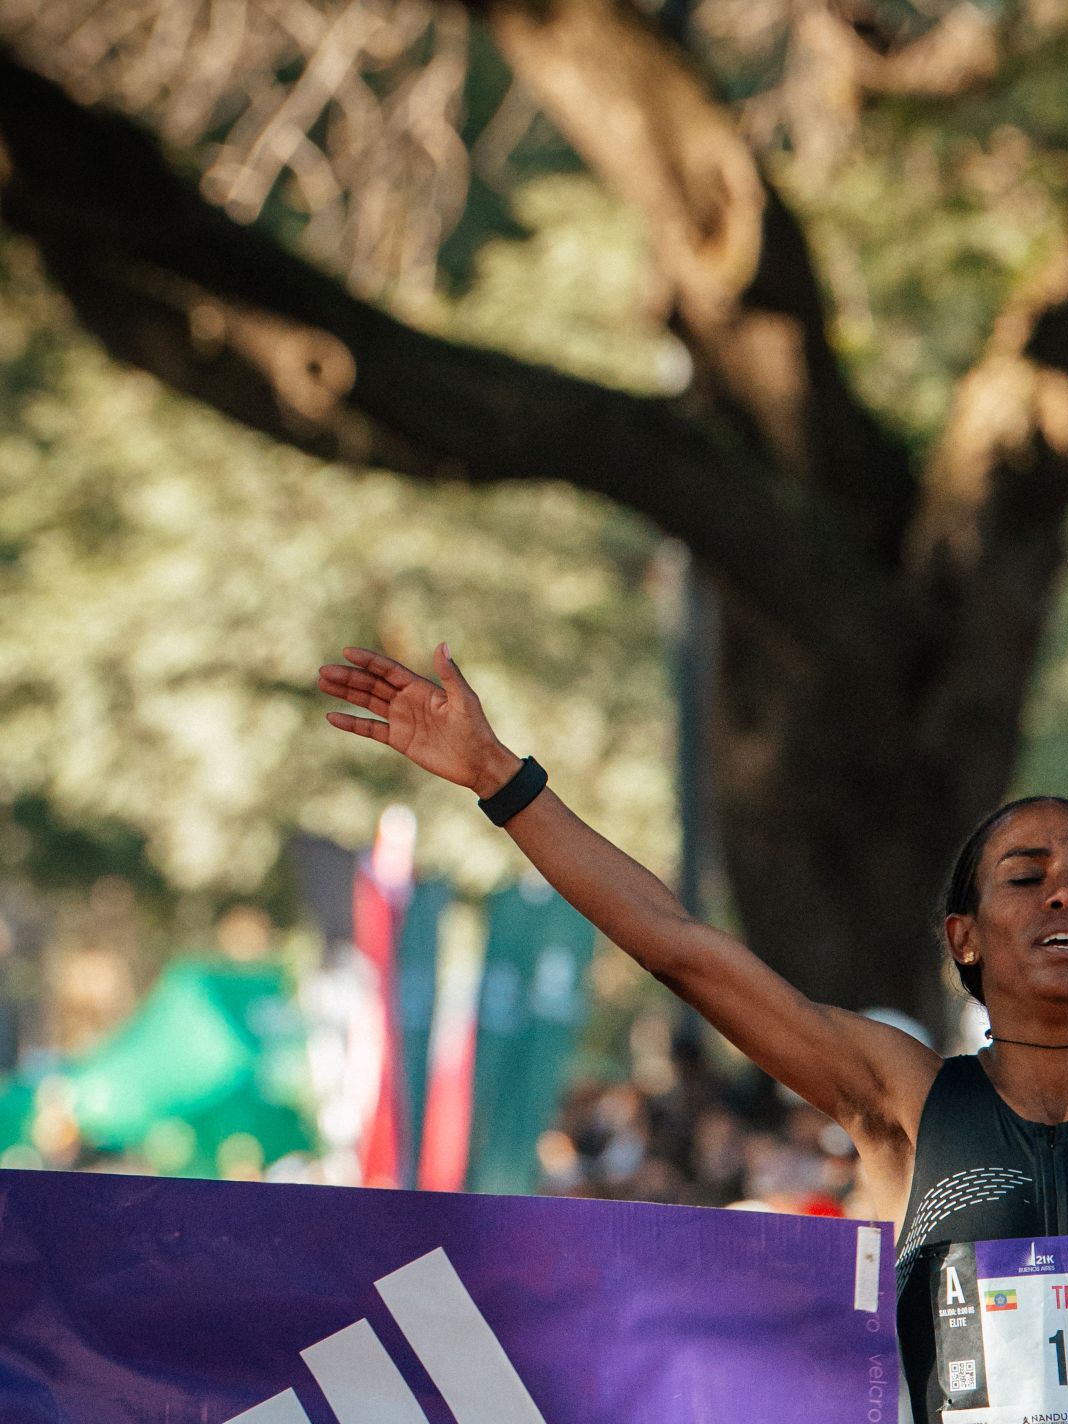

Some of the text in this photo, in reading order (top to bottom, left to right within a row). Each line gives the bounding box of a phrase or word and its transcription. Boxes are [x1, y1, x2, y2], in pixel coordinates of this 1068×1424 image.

[1036, 1255, 1054, 1264] 21K
[946, 1266, 966, 1305] A
[949, 1317, 967, 1328] ELITE
[867, 1354, 888, 1423] velcro
